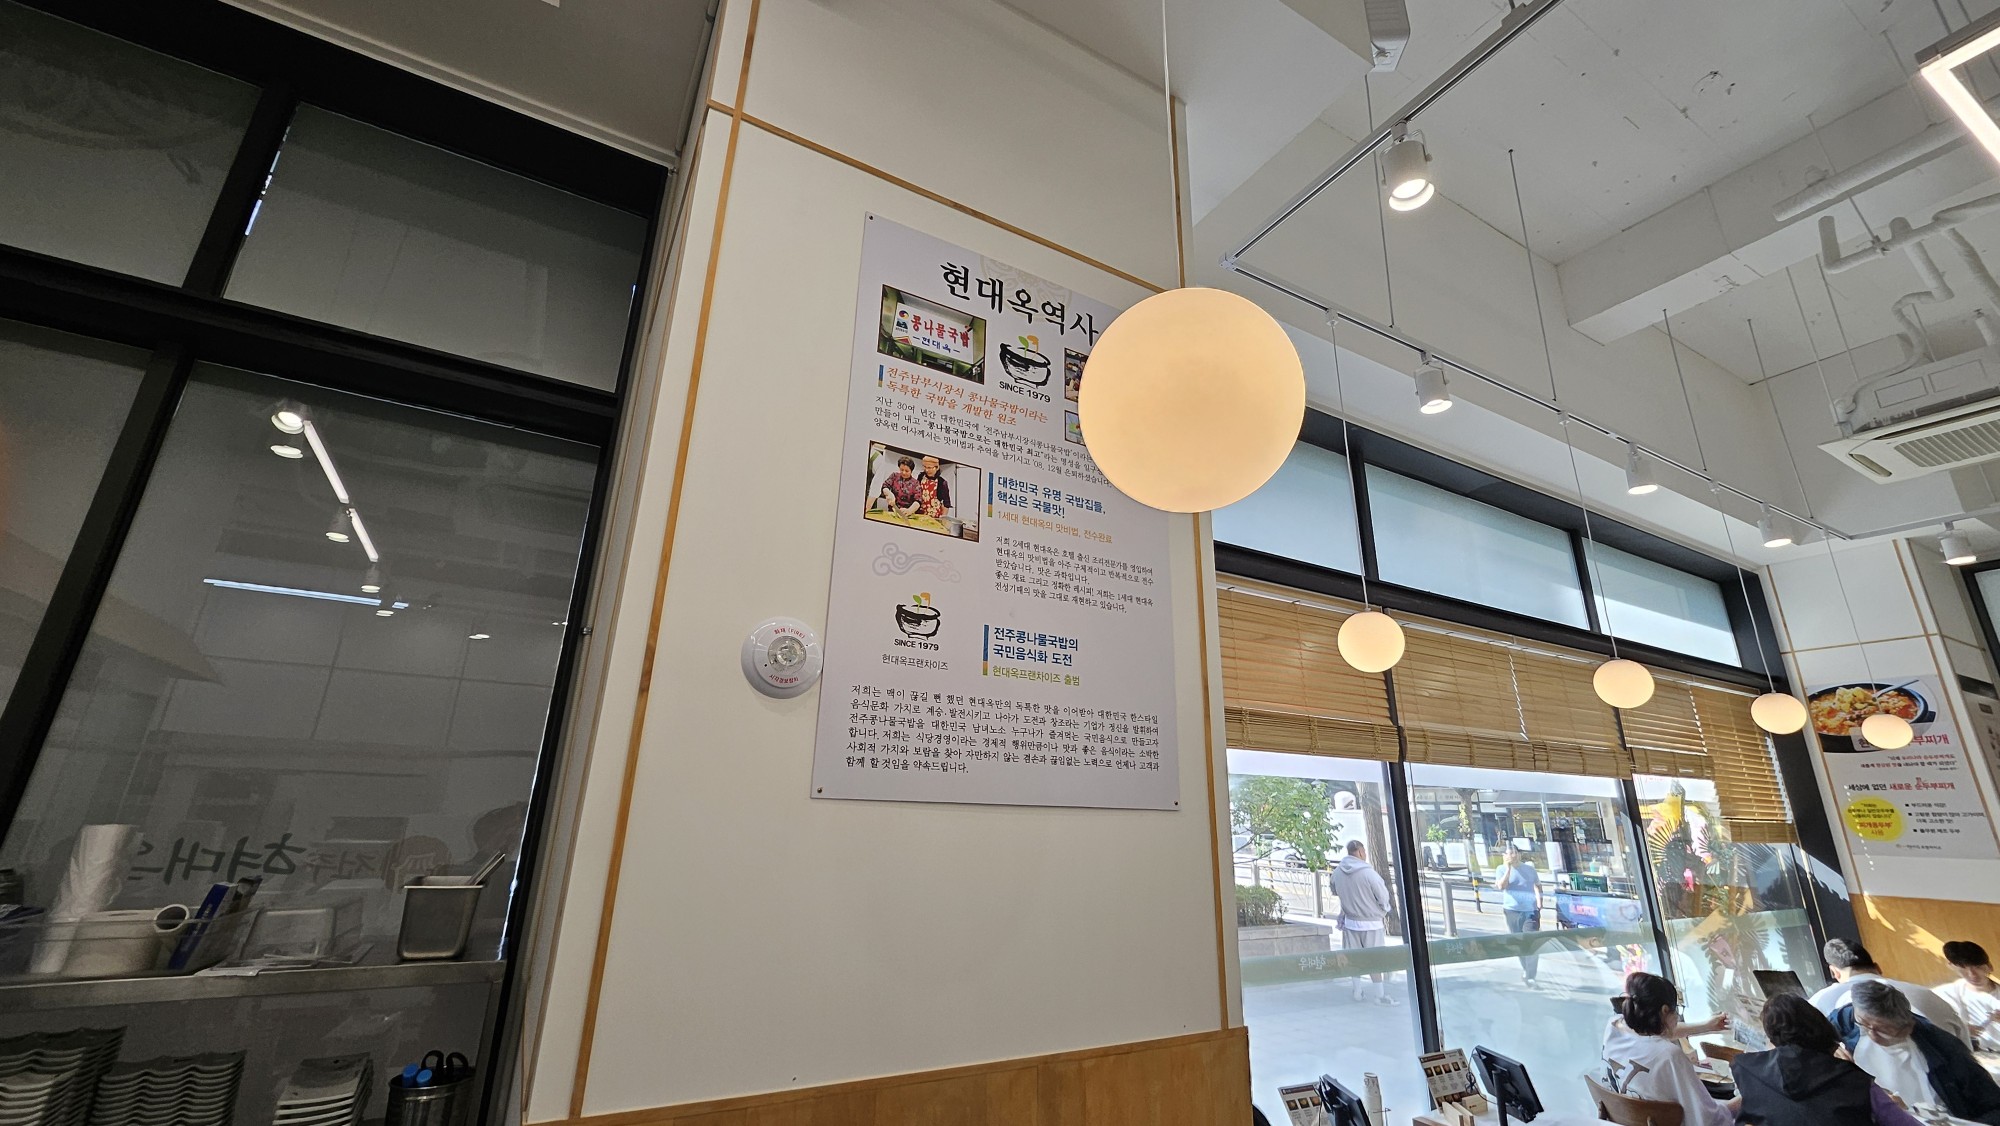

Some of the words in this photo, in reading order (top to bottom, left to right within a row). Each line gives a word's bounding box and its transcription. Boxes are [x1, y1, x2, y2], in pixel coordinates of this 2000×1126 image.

[939, 261, 1100, 347] 현대옥역사
[911, 314, 970, 348] 콩나물국밥
[922, 336, 951, 353] 현대옥
[886, 367, 964, 399] 전주남부시장식
[967, 391, 1048, 424] 콩나물국밥이라는
[886, 380, 922, 399] 독특한
[924, 391, 958, 410] 국밥을
[961, 403, 993, 420] 개발한
[996, 412, 1016, 426] 원조
[998, 380, 1024, 395] SINCE
[1026, 389, 1051, 403] 1979
[875, 396, 893, 408] 지난
[896, 401, 915, 414] 30여
[920, 408, 936, 420] 년간
[940, 414, 979, 432] 대한민국에
[874, 406, 900, 421] 만들어
[904, 414, 920, 425] 내고
[993, 439, 1023, 454] 대한민국
[1060, 457, 1081, 469] 명성을
[943, 436, 975, 452] 맛비법과
[976, 444, 999, 458] 추억을
[1001, 451, 1030, 466] 남기시고
[1047, 464, 1062, 475] 12월
[997, 476, 1038, 496] 대한민국
[1041, 487, 1061, 502] 유명
[1064, 493, 1106, 515] 국밥집들,
[997, 490, 1028, 509] 핵심은
[1031, 498, 1065, 519] 국물맛!
[997, 510, 1019, 524] 1세대
[1021, 514, 1053, 532] 현대옥의
[1055, 523, 1081, 538] 맛비법,
[1083, 529, 1112, 544] 전수완료
[995, 535, 1010, 546] 저희
[1012, 539, 1030, 551] 2세대
[1032, 543, 1059, 557] 현대옥은
[1061, 549, 1075, 560] 호텔
[1129, 564, 1153, 576] 영입하여
[995, 558, 1034, 574] 받았습니다.
[1037, 566, 1052, 577] 맛은
[1053, 570, 1090, 585] 과학입니다.
[996, 547, 1025, 561] 현대옥의
[1027, 553, 1056, 567] 맛비법을
[1057, 559, 1072, 570] 아주
[1073, 562, 1106, 576] 구체적이고
[1108, 570, 1140, 583] 반복적으로
[1141, 576, 1154, 586] 전수
[994, 569, 1010, 581] 좋은
[1011, 573, 1026, 583] 재료
[1028, 576, 1049, 587] 그리고
[1051, 580, 1071, 592] 정확한
[1073, 584, 1094, 597] 레시피!
[1096, 589, 1115, 600] 저희는
[1117, 593, 1133, 603] 1세대
[1135, 596, 1154, 607] 현대옥
[1032, 588, 1047, 599] 맛을
[1048, 592, 1069, 602] 그대로
[1071, 595, 1098, 607] 재현하고
[1099, 600, 1127, 614] 있습니다.
[893, 638, 916, 648] SINCE
[917, 641, 939, 651] 1979
[992, 643, 1048, 664] 국민음식화
[1051, 652, 1072, 667] 도전
[993, 627, 1078, 652] 전주콩나물국밥의
[881, 653, 948, 670] 현대옥프랜차이즈
[992, 665, 1061, 683] 현대옥프랜차이즈
[1063, 673, 1080, 686] 출범
[850, 698, 889, 712] 음식문화
[893, 702, 921, 714] 가치로
[995, 711, 1019, 724] 나아가
[1022, 715, 1047, 726] 도전과
[1050, 717, 1080, 730] 창조라는
[1083, 720, 1105, 731] 기업가
[1108, 722, 1129, 734] 정신을
[1132, 724, 1159, 736] 발휘하여
[851, 684, 882, 698] 저희는
[886, 688, 905, 700] 맥이
[933, 692, 942, 704] 뻔
[946, 694, 964, 706] 했던
[968, 696, 1011, 710] 현대옥만의
[1015, 701, 1040, 714] 독특한
[1043, 704, 1060, 715] 맛을
[1063, 706, 1094, 718] 이어받아
[1097, 709, 1127, 721] 대한민국
[1130, 712, 1158, 725] 한스타일
[848, 712, 925, 729] 전주콩나물국밥을
[931, 719, 967, 732] 대한민국
[972, 722, 1006, 734] 남녀노소
[1011, 726, 1044, 739] 누구나가
[1048, 729, 1079, 742] 즐겨먹는
[1083, 732, 1127, 744] 국민음식으로
[1131, 736, 1159, 747] 만들고자
[882, 729, 910, 742] 저희는
[915, 731, 977, 747] 식당경영이라는
[982, 737, 1006, 749] 경제적
[1062, 743, 1078, 754] 맛과
[1081, 744, 1096, 756] 좋은
[1100, 746, 1135, 758] 음식이라는
[1139, 749, 1159, 760] 소박한
[845, 755, 865, 768] 함께
[869, 757, 880, 768] 할
[881, 757, 910, 770] 것임을
[912, 759, 968, 773] 약속드립니다.
[846, 741, 876, 754] 사회적
[880, 743, 909, 756] 가치와
[912, 746, 941, 758] 보람을
[943, 747, 962, 760] 찾아
[965, 748, 999, 762] 자만하지
[1003, 751, 1020, 763] 않는
[1023, 753, 1047, 765] 겸손과
[1083, 757, 1113, 768] 노력으로
[1115, 759, 1136, 770] 언제나
[1139, 761, 1160, 772] 고객과
